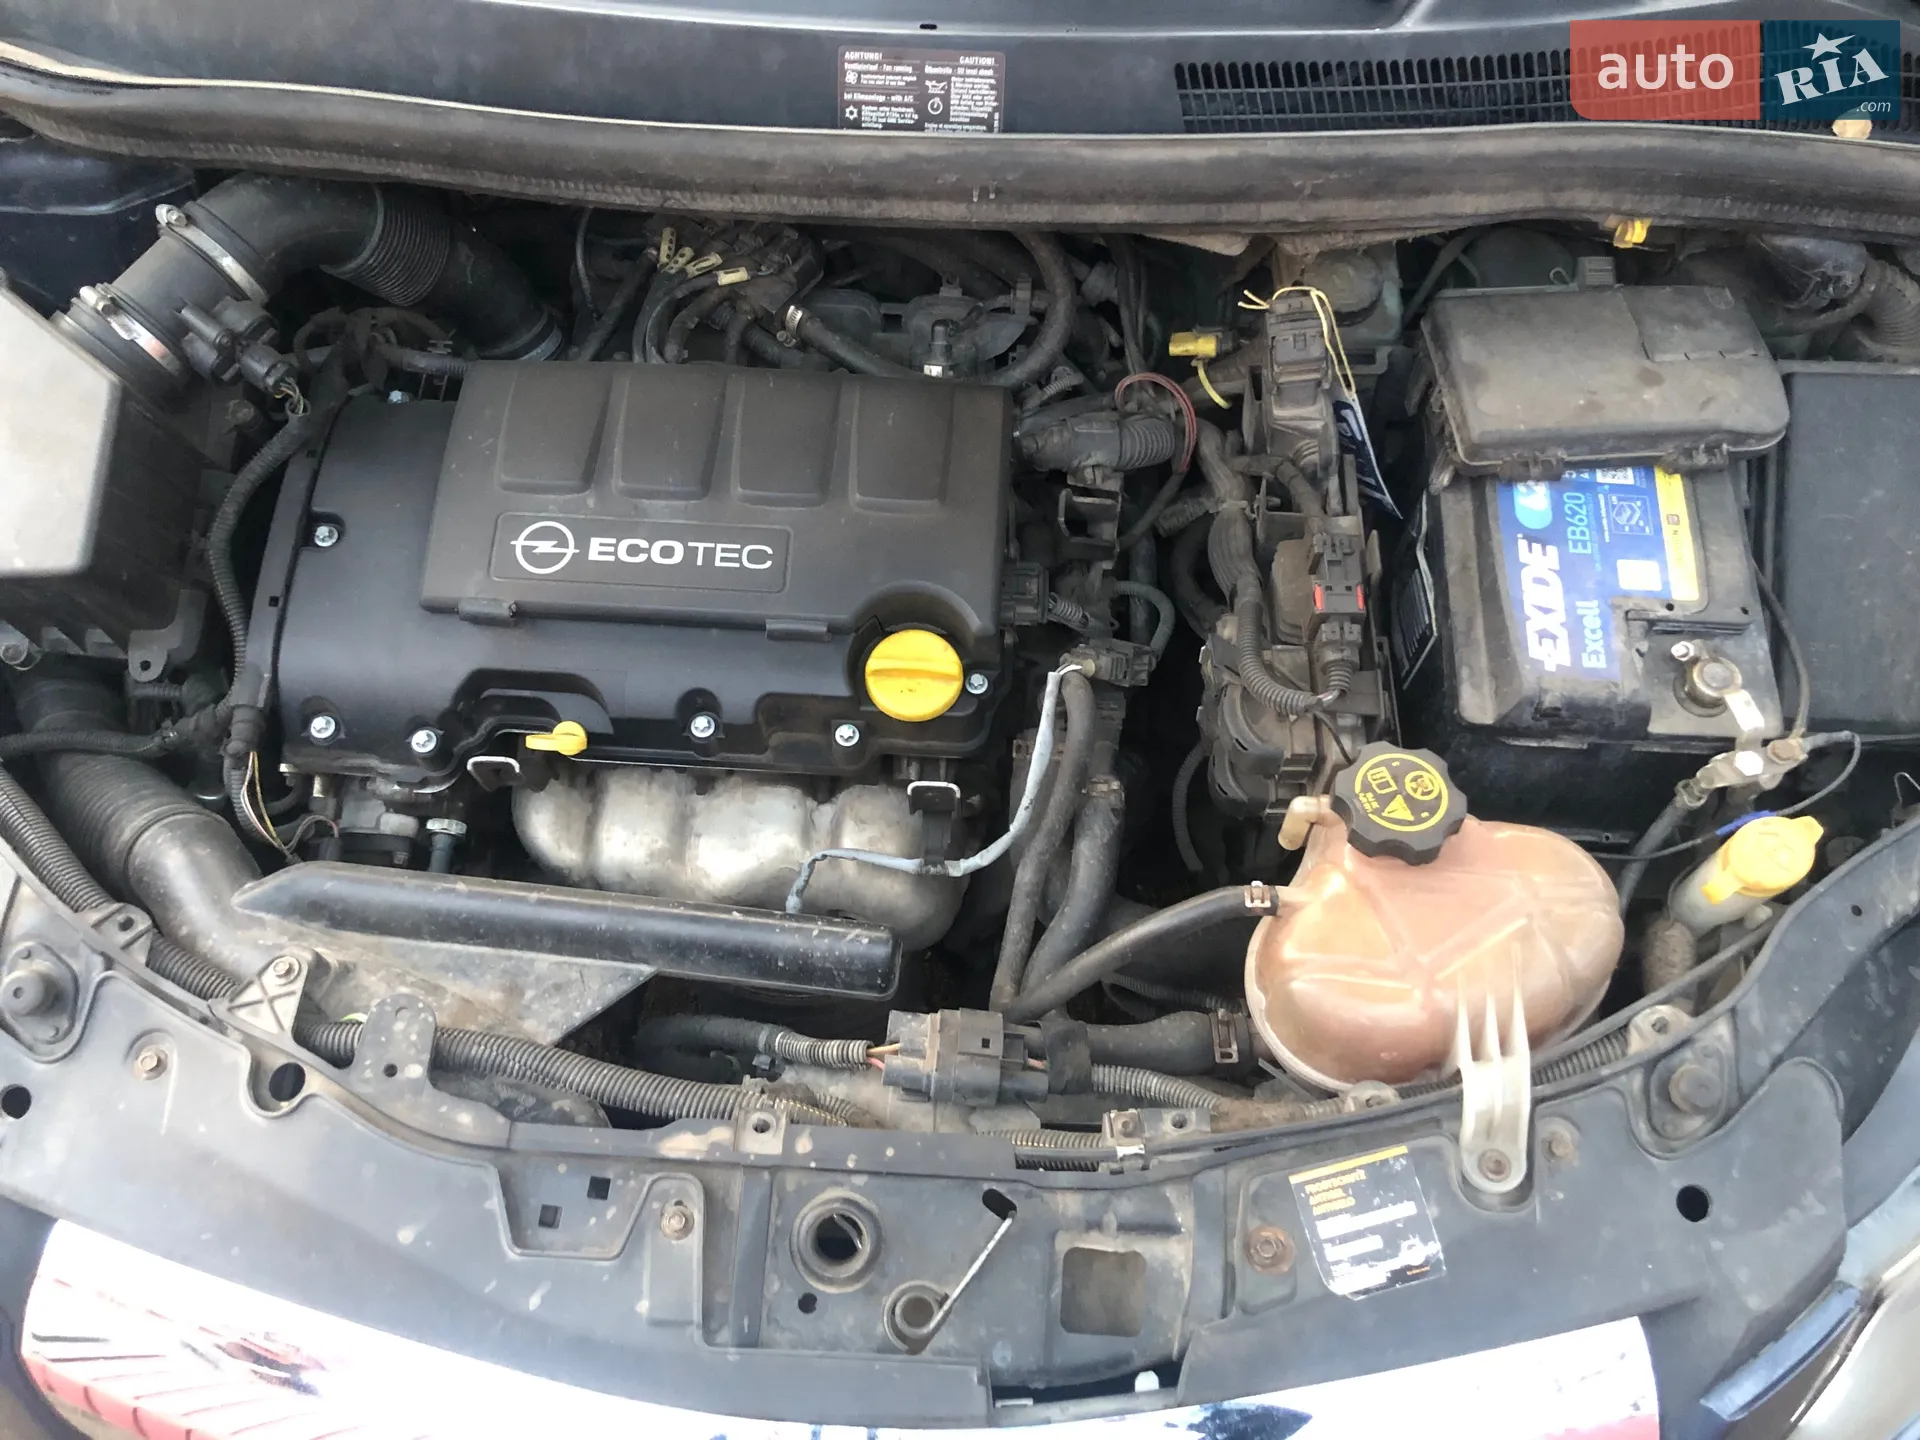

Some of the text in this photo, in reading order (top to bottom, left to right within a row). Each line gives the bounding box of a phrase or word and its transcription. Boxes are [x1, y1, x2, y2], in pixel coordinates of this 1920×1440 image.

[844, 51, 883, 60] ACHTUNG!
[959, 56, 995, 65] CAUTION!
[1562, 491, 1592, 554] EB620
[587, 536, 774, 570] ECOTEC
[1517, 537, 1572, 672] EXIDE
[1575, 599, 1607, 669] Excell
